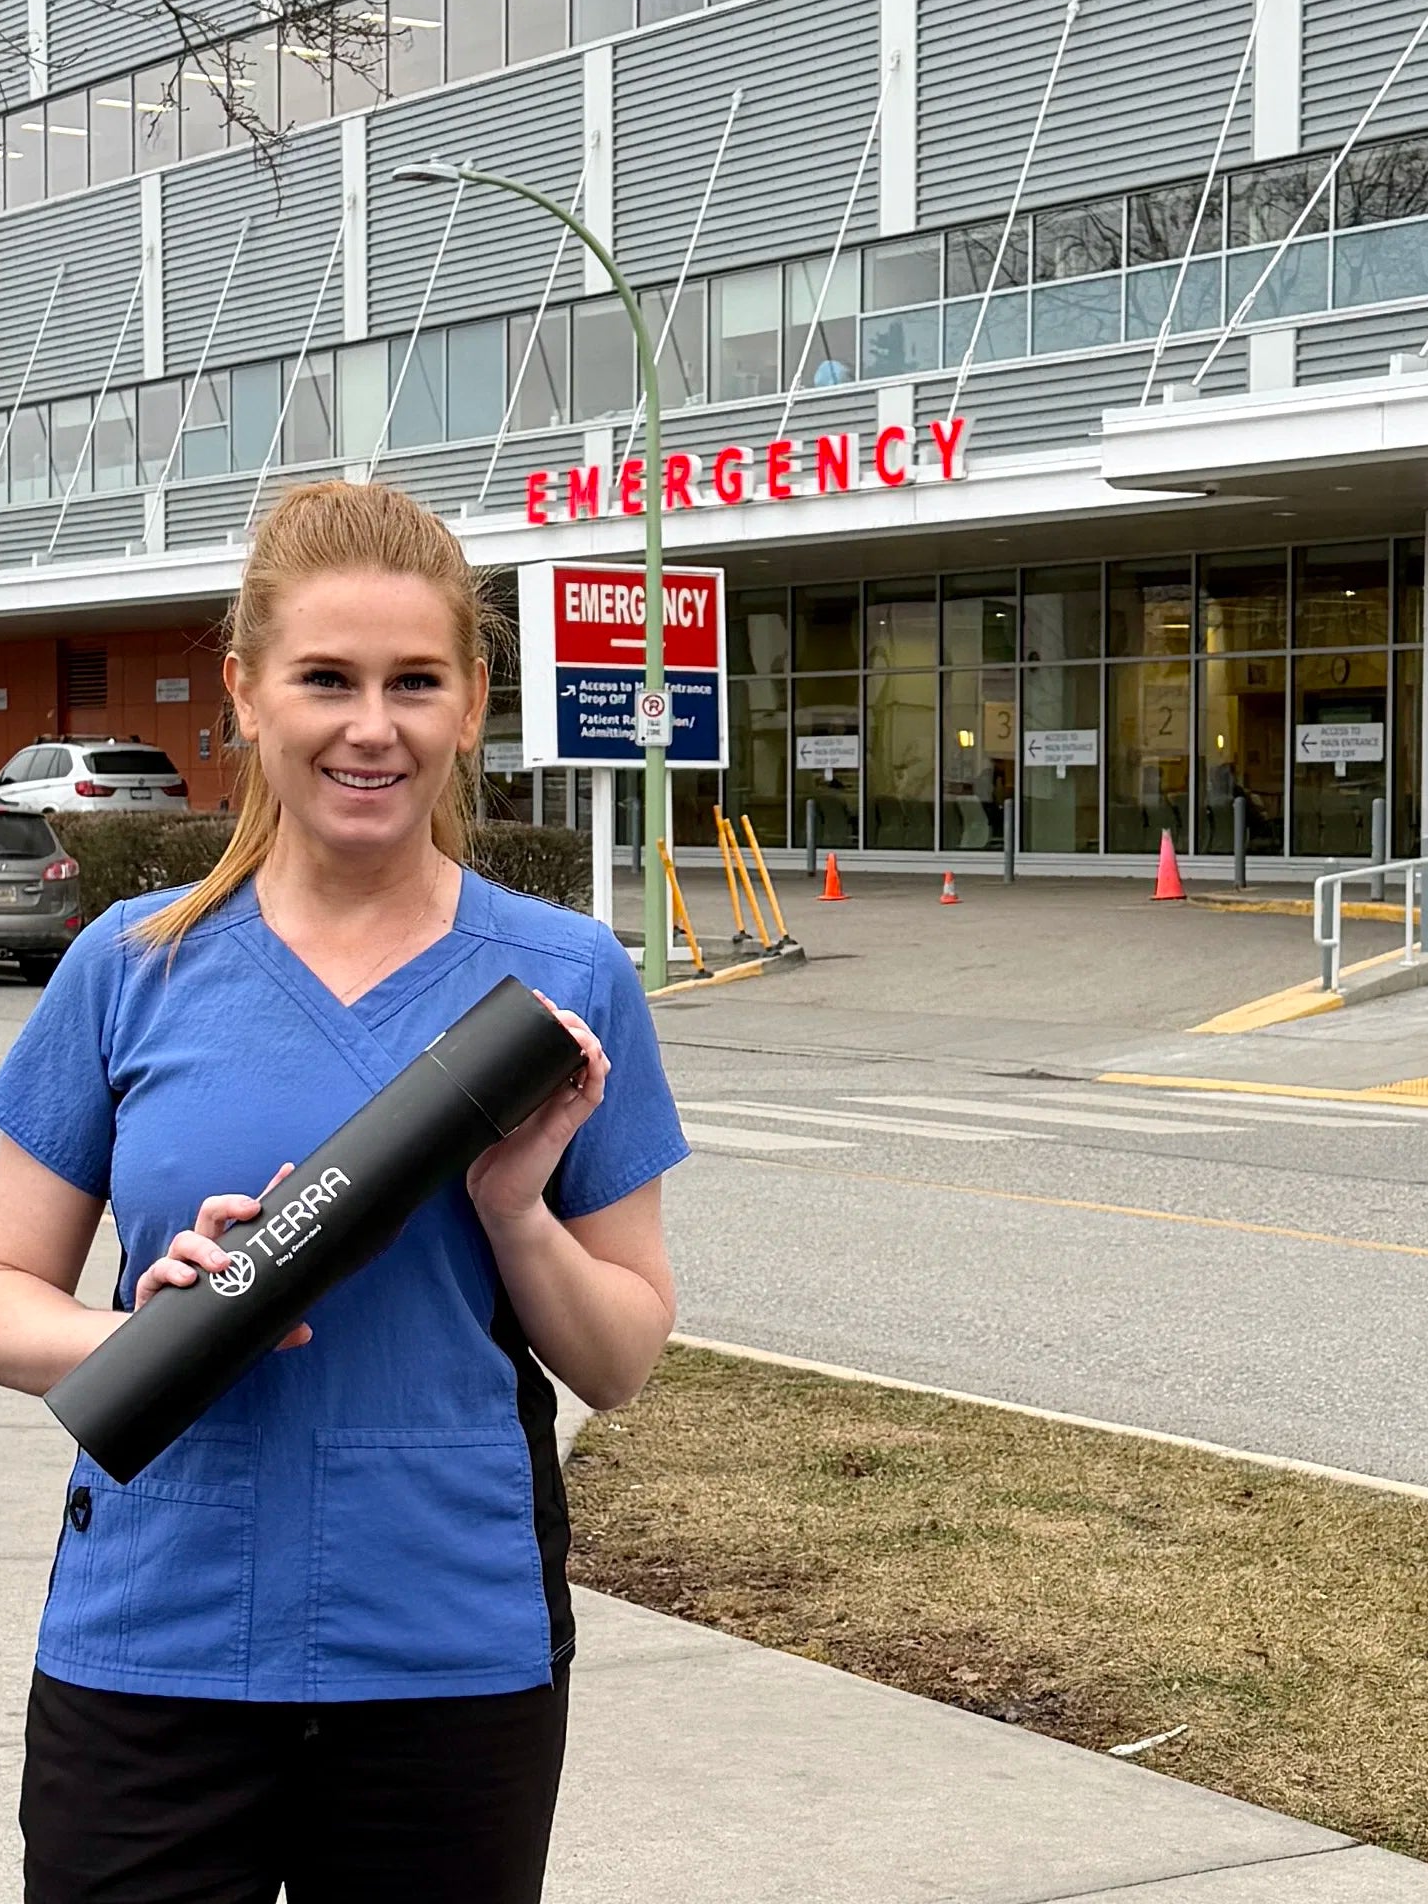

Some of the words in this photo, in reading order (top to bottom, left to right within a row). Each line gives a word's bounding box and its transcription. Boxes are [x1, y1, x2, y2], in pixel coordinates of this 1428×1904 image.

[525, 417, 968, 525] EMERGENCY
[565, 582, 709, 628] EMERGNCY
[579, 680, 618, 692] Access
[620, 681, 633, 692] to
[579, 693, 607, 707] Drop
[609, 694, 627, 704] Off
[579, 713, 619, 725] Patient
[997, 711, 1011, 739] 3
[1159, 706, 1172, 736] 2
[581, 727, 636, 741] Admitting
[245, 1166, 351, 1257] TERRA
